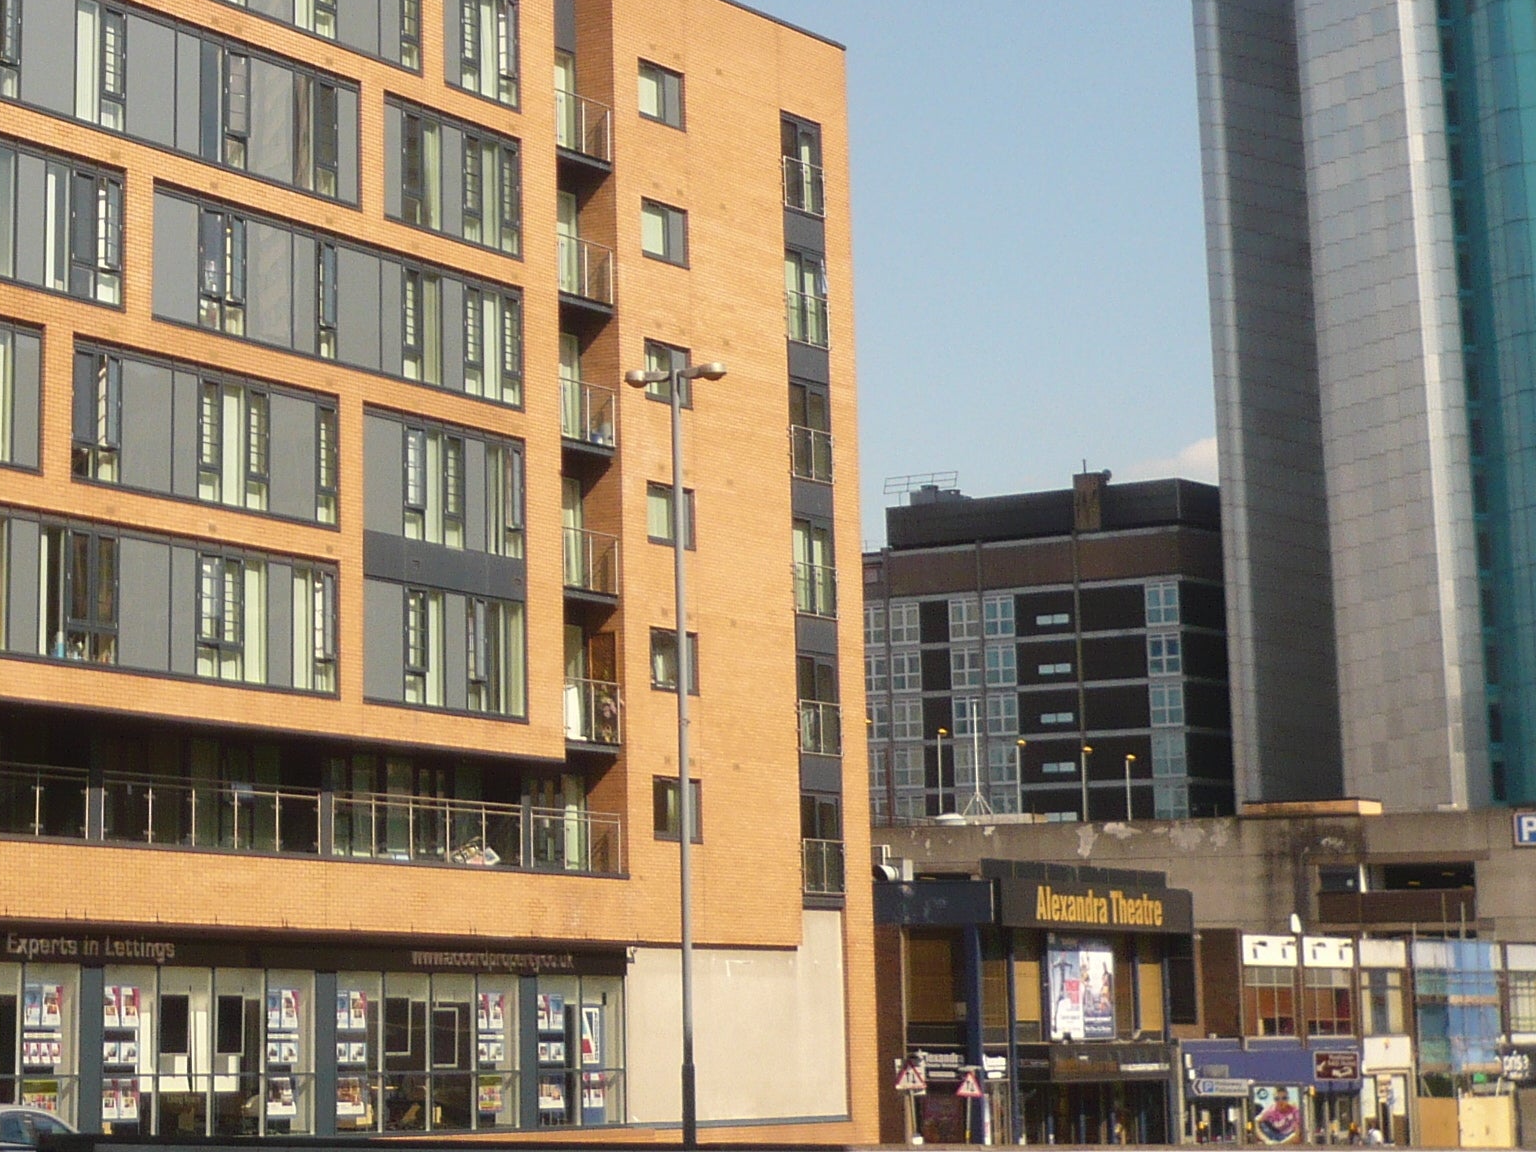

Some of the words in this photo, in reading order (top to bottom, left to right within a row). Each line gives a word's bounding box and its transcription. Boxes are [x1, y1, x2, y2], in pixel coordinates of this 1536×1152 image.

[1036, 885, 1108, 924] Alexandra
[1109, 890, 1163, 926] Theatre
[6, 932, 78, 960] Experts
[83, 934, 99, 956] in
[105, 935, 176, 963] Lettings
